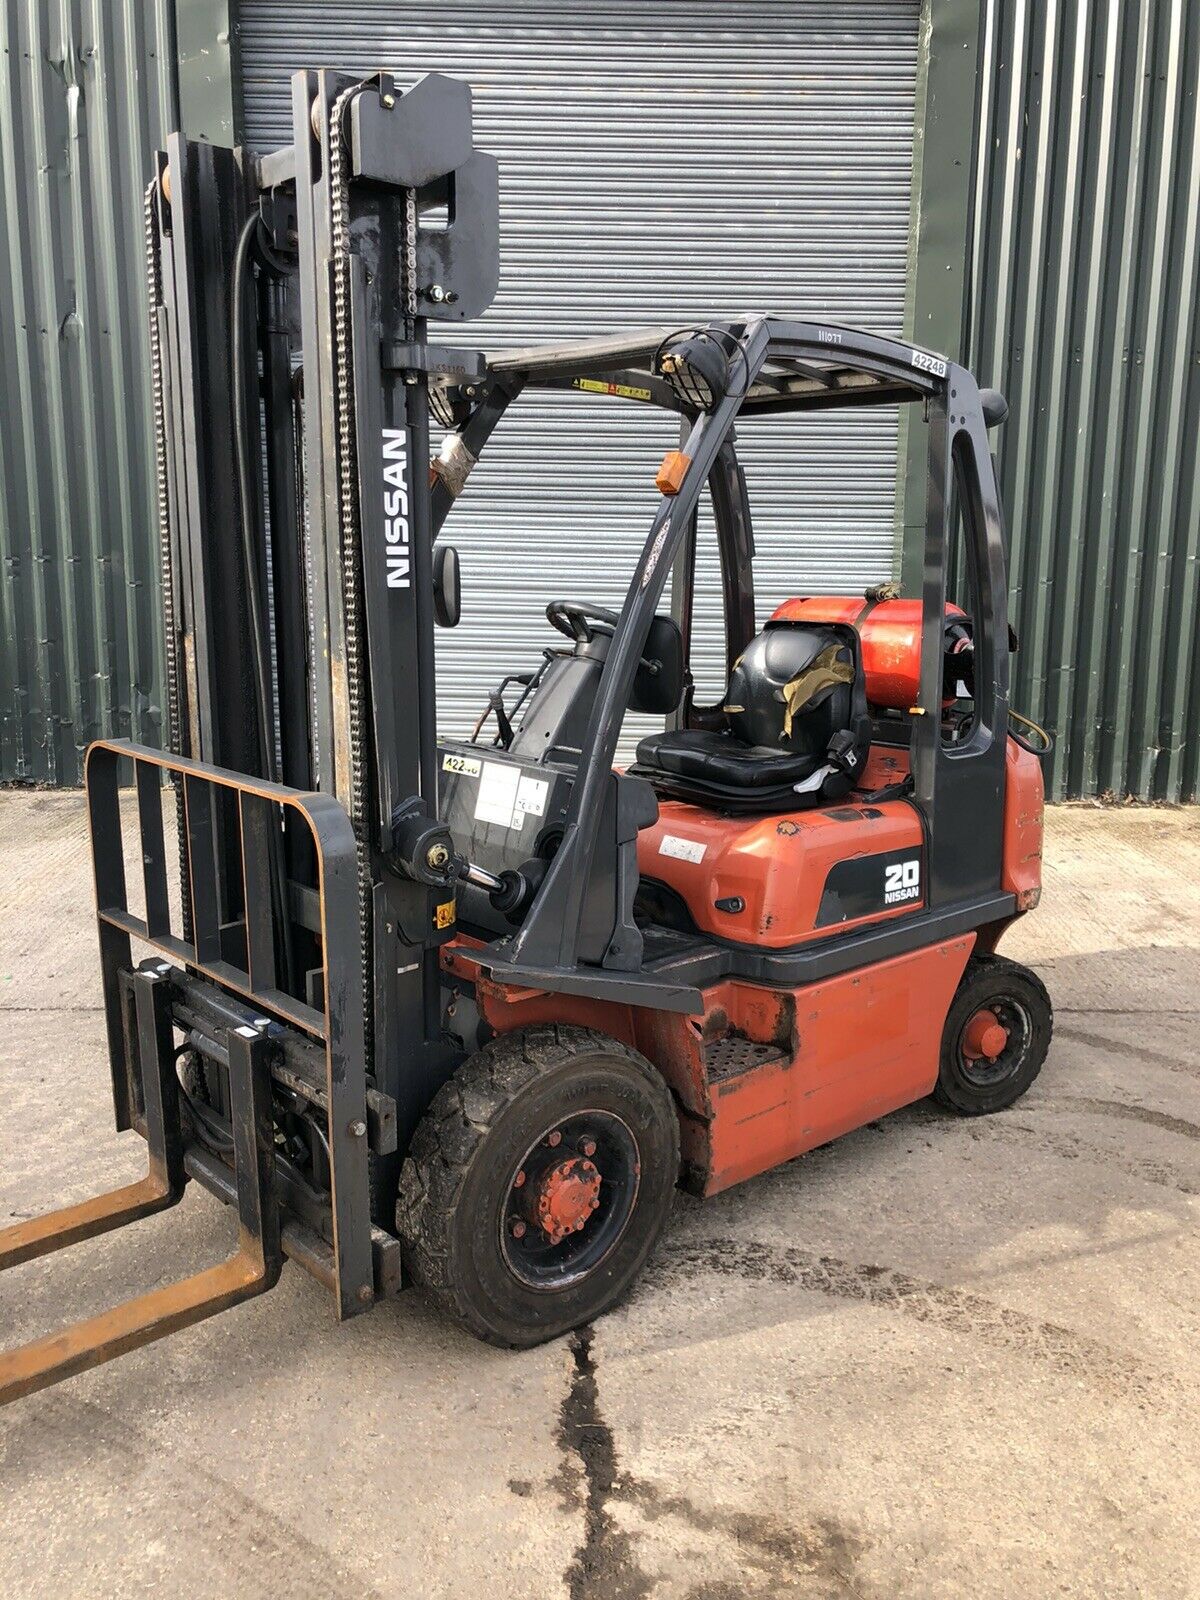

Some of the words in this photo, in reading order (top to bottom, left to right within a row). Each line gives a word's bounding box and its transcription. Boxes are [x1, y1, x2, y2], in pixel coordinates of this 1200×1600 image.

[913, 353, 945, 375] 42248
[381, 428, 411, 588] NISSAN
[445, 757, 478, 775] 422
[885, 860, 919, 892] 20
[885, 886, 919, 904] NISSAN
